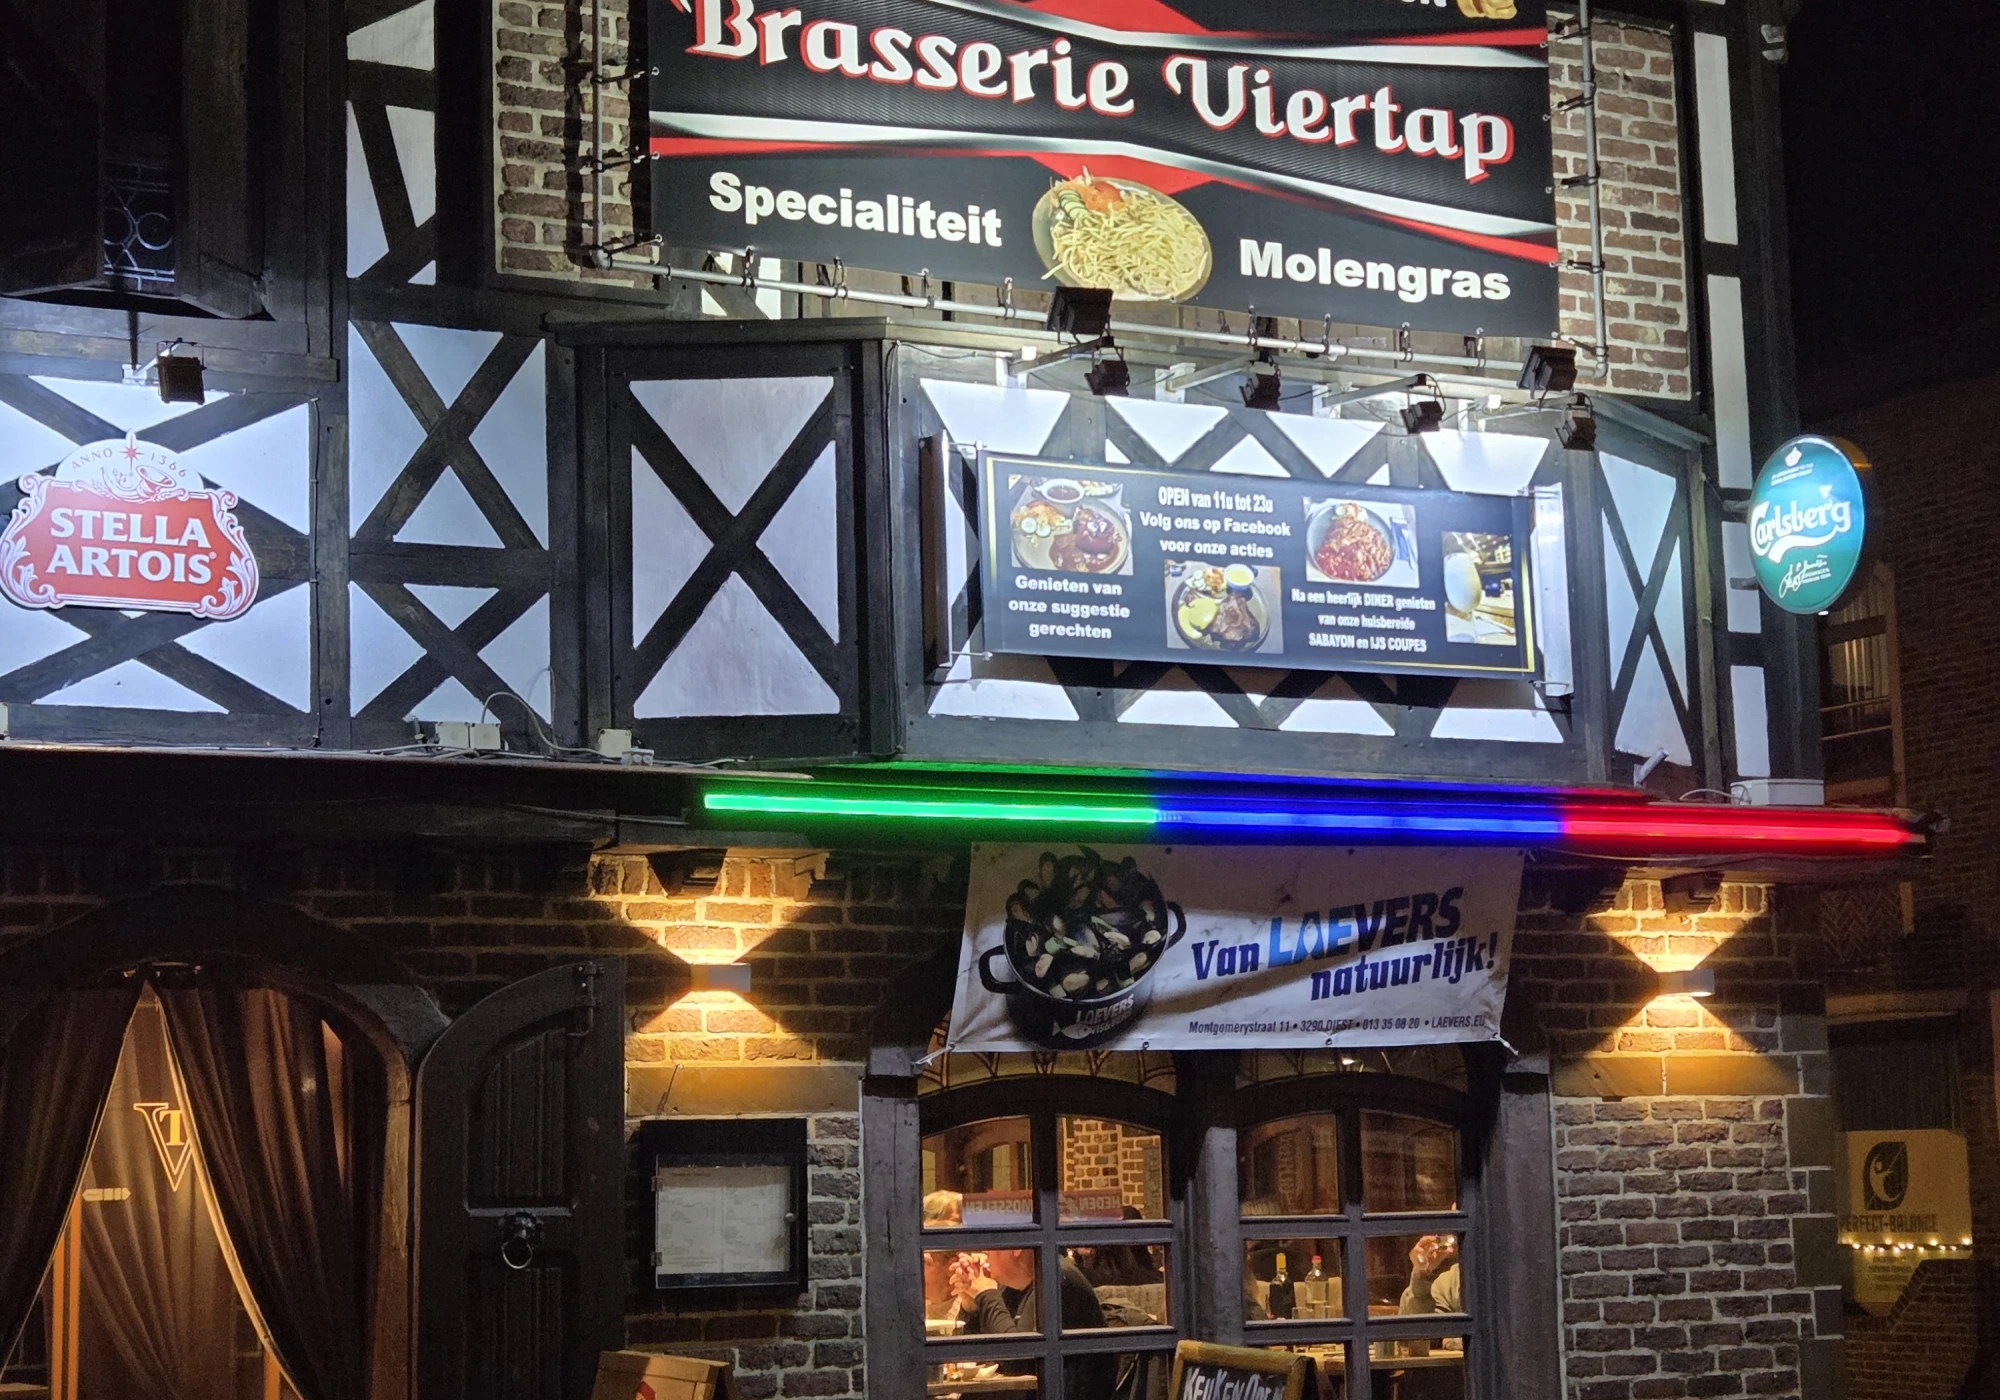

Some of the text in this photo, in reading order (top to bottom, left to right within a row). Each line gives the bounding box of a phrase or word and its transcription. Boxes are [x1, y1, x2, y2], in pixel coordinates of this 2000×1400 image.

[678, 0, 1514, 183] Brasserie Viertap
[709, 171, 1511, 303] Specialiteit Molengras
[71, 447, 187, 478] ANNO 1366
[1158, 486, 1274, 513] OPEN van 11u tot 23u
[51, 507, 211, 548] STELLA
[1139, 511, 1291, 536] Volg ons op Facebook
[1751, 499, 1852, 558] Carlsberg
[1160, 539, 1274, 558] voor onze acties
[46, 544, 213, 584] ARTOIS
[1015, 574, 1123, 596] Genieten van
[1008, 599, 1131, 619] onze suggestie
[1291, 588, 1436, 611] Na een heerlijk DINER genieten
[1029, 623, 1113, 639] gerechten
[1317, 614, 1416, 631] van onze huisbereide
[1308, 632, 1427, 653] SABAYON en IJS COUPES
[1191, 887, 1465, 980] Van LAEVERS
[1311, 931, 1498, 1001] natuurlijk!
[1188, 1021, 1277, 1035] Montgomerystraat
[1279, 1020, 1291, 1033] 11
[1300, 1019, 1323, 1032] 3290
[1362, 1017, 1379, 1030] 013
[1381, 1017, 1393, 1030] 35
[1395, 1017, 1406, 1030] 08
[1408, 1017, 1420, 1029] 20
[1431, 1014, 1485, 1029] LAEVERS.EU
